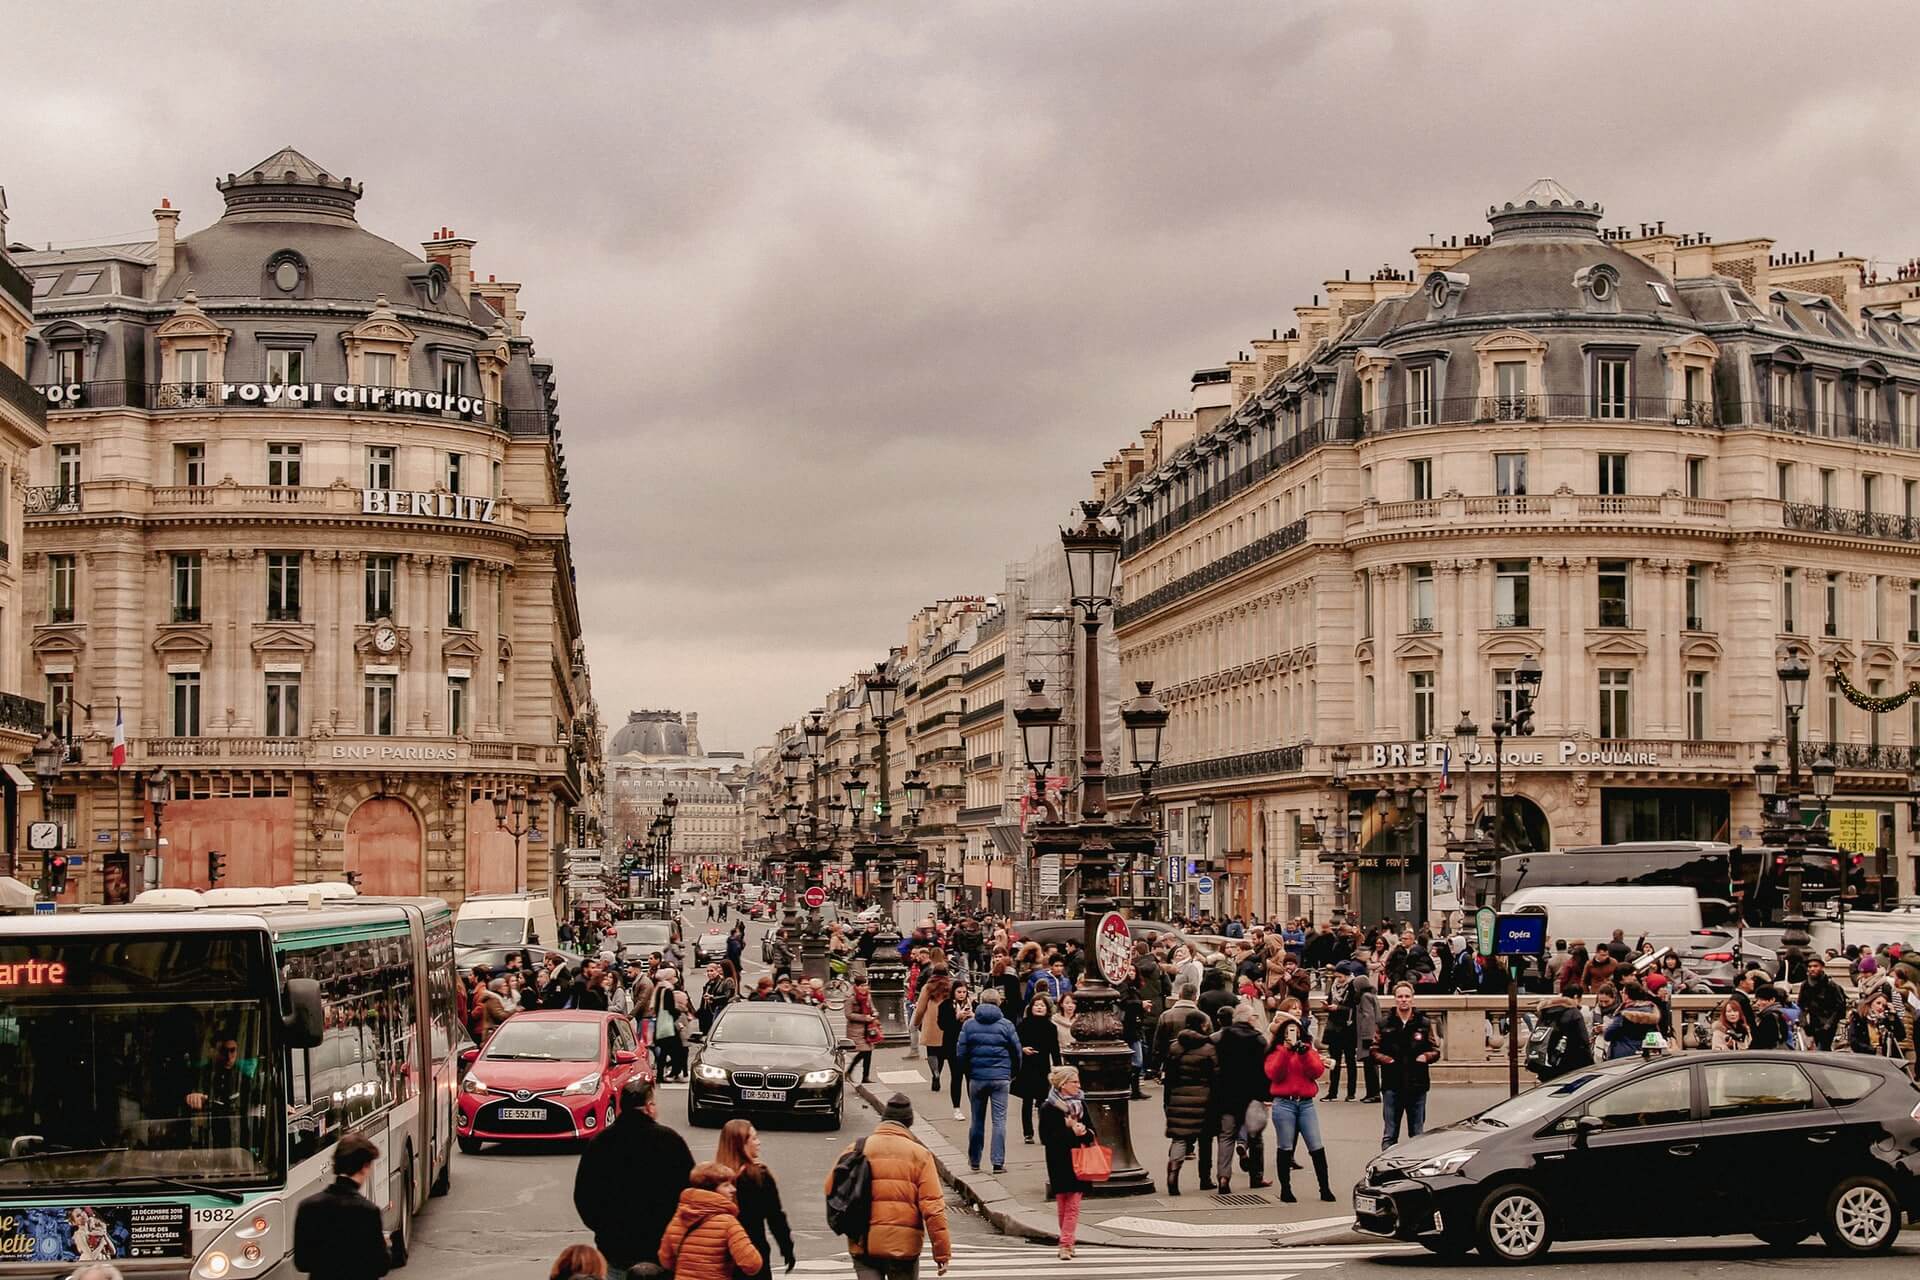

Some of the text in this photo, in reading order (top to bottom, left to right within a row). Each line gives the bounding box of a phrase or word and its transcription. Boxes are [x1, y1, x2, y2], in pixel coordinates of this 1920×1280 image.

[220, 383, 484, 416] royal air maroc
[362, 489, 497, 523] BERLITZ
[332, 746, 457, 760] BNP PARIBAS
[1373, 743, 1452, 768] BRED
[1560, 741, 1657, 765] POPULAIRE
[1386, 858, 1409, 867] PRIVE
[1508, 930, 1531, 940] Opéra
[0, 959, 65, 984] artre
[194, 1208, 235, 1223] 1982
